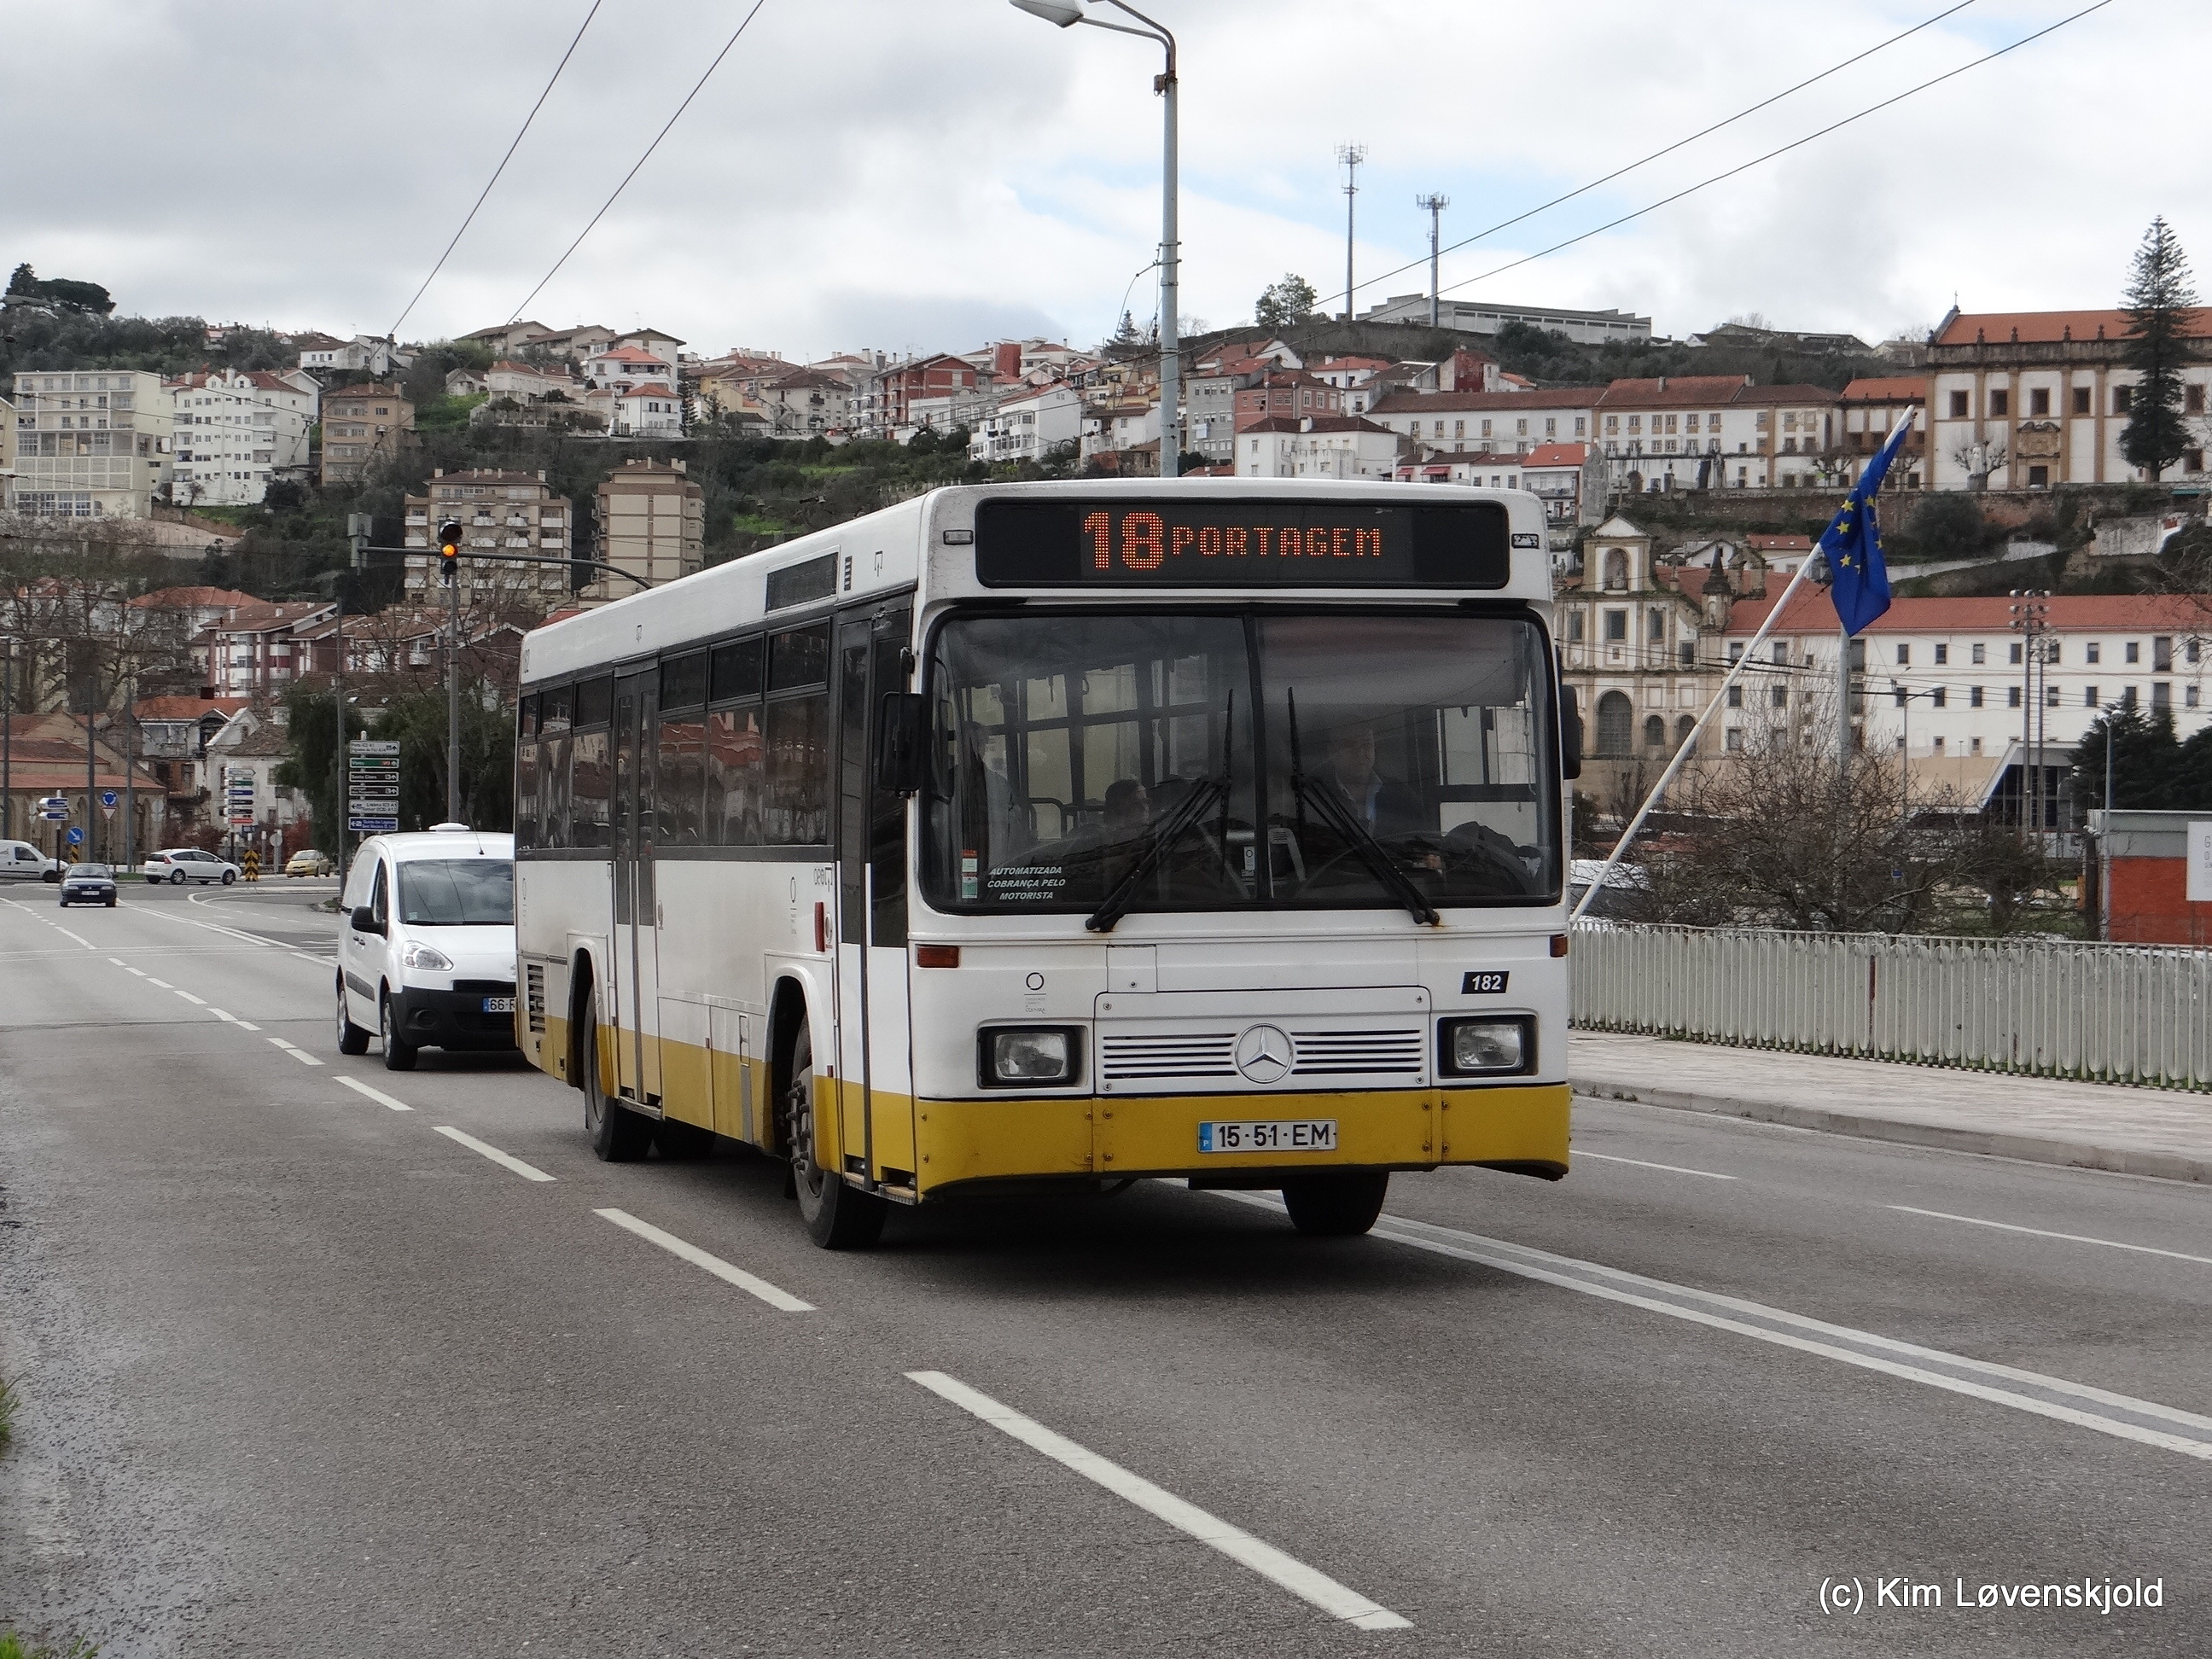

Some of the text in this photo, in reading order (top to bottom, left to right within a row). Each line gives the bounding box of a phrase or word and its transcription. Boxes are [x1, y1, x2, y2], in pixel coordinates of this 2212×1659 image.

[1084, 511, 1381, 568] 18 PORTAGEM
[989, 866, 1062, 876] AUTOMATIZADA
[987, 878, 1066, 889] COBRANÇA PELO
[999, 891, 1053, 900] MOTORISTA
[1472, 975, 1502, 991] 182
